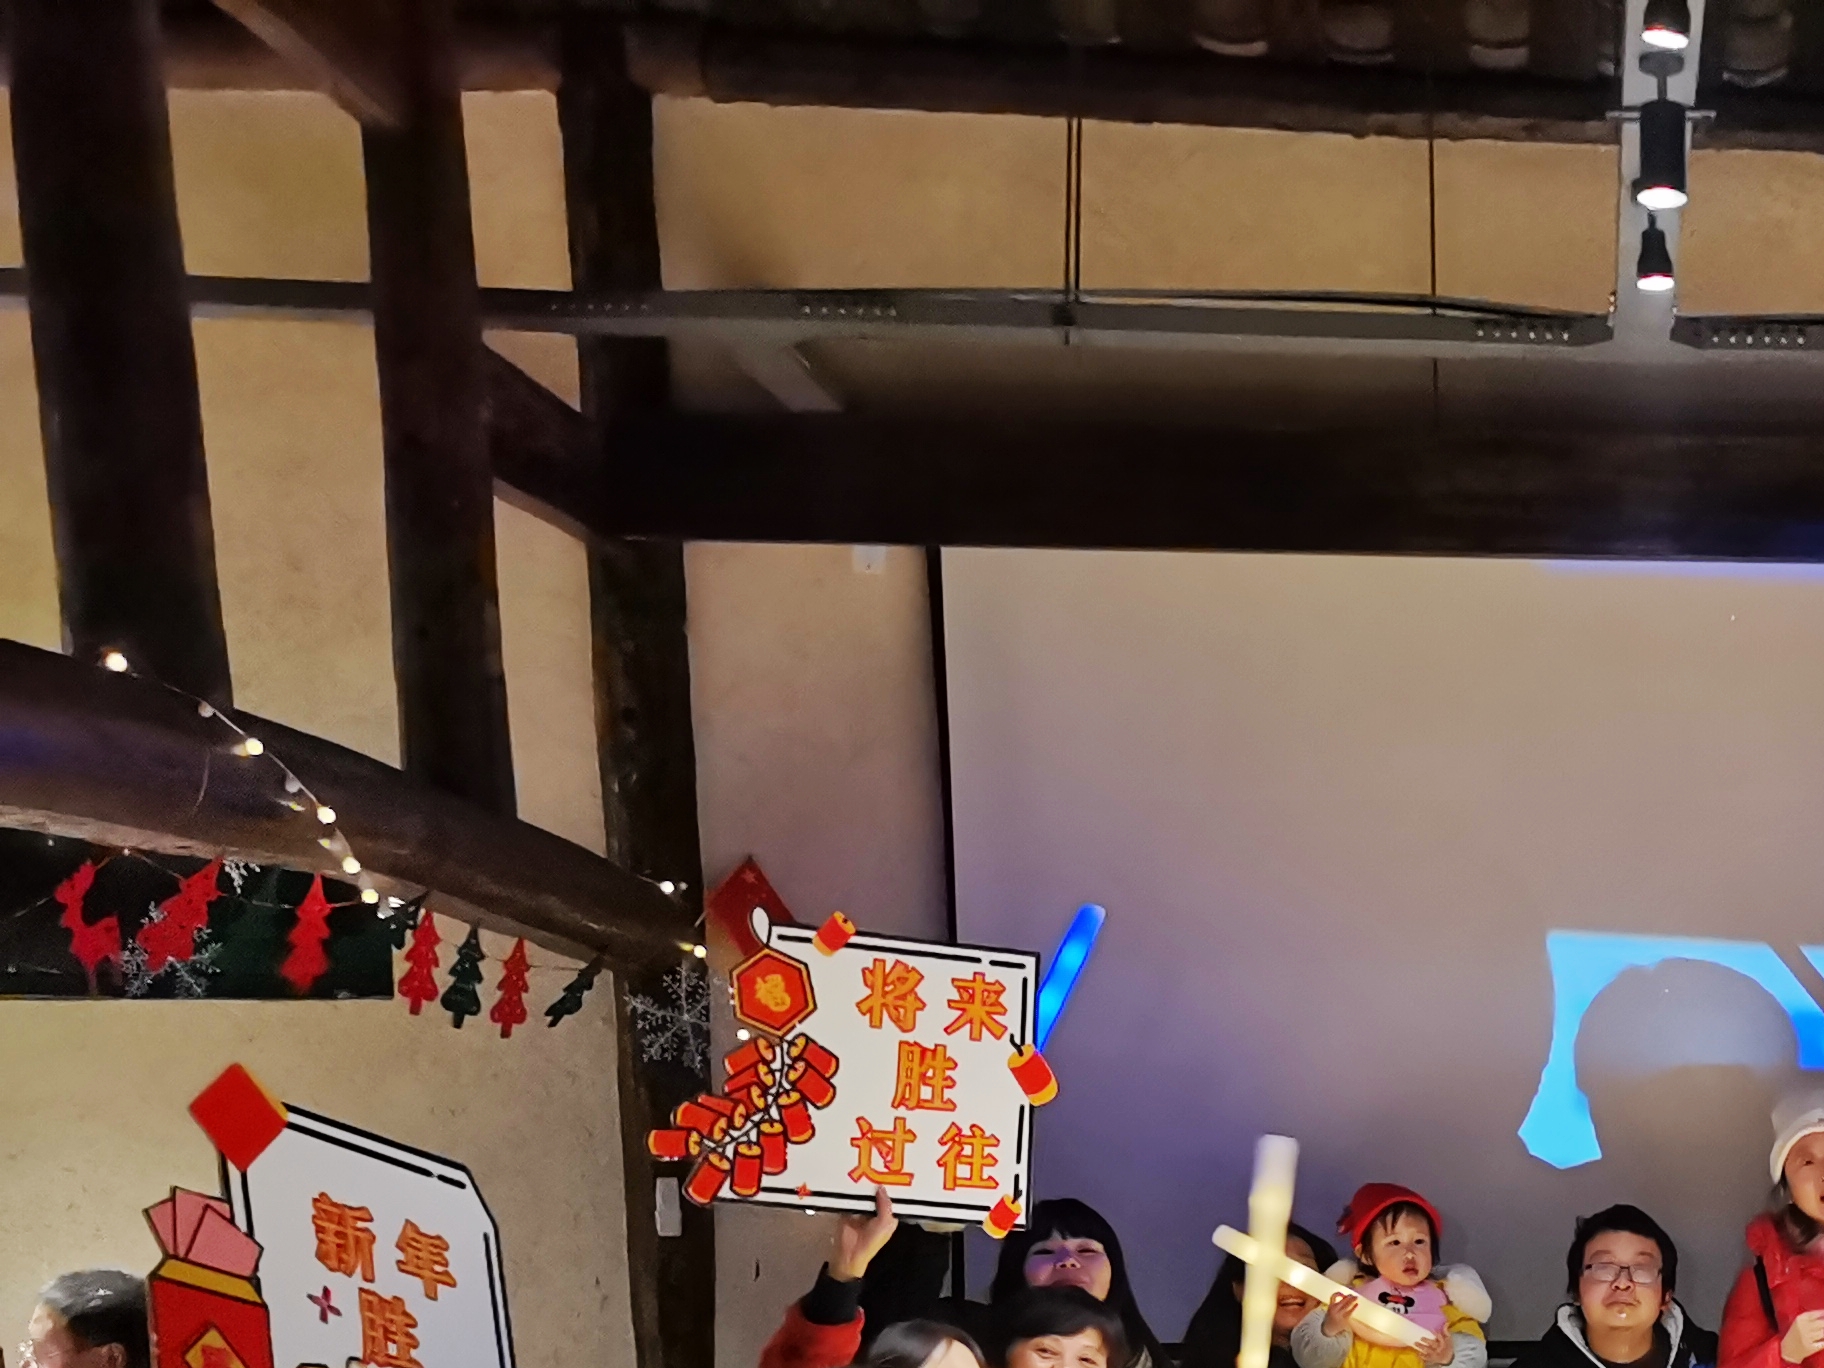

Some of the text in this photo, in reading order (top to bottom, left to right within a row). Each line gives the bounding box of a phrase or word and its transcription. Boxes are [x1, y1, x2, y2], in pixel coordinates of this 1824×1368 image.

[856, 958, 1008, 1041] 将来
[891, 1041, 957, 1111] 胜
[848, 1116, 1001, 1190] 过往
[311, 1191, 458, 1300] 新年
